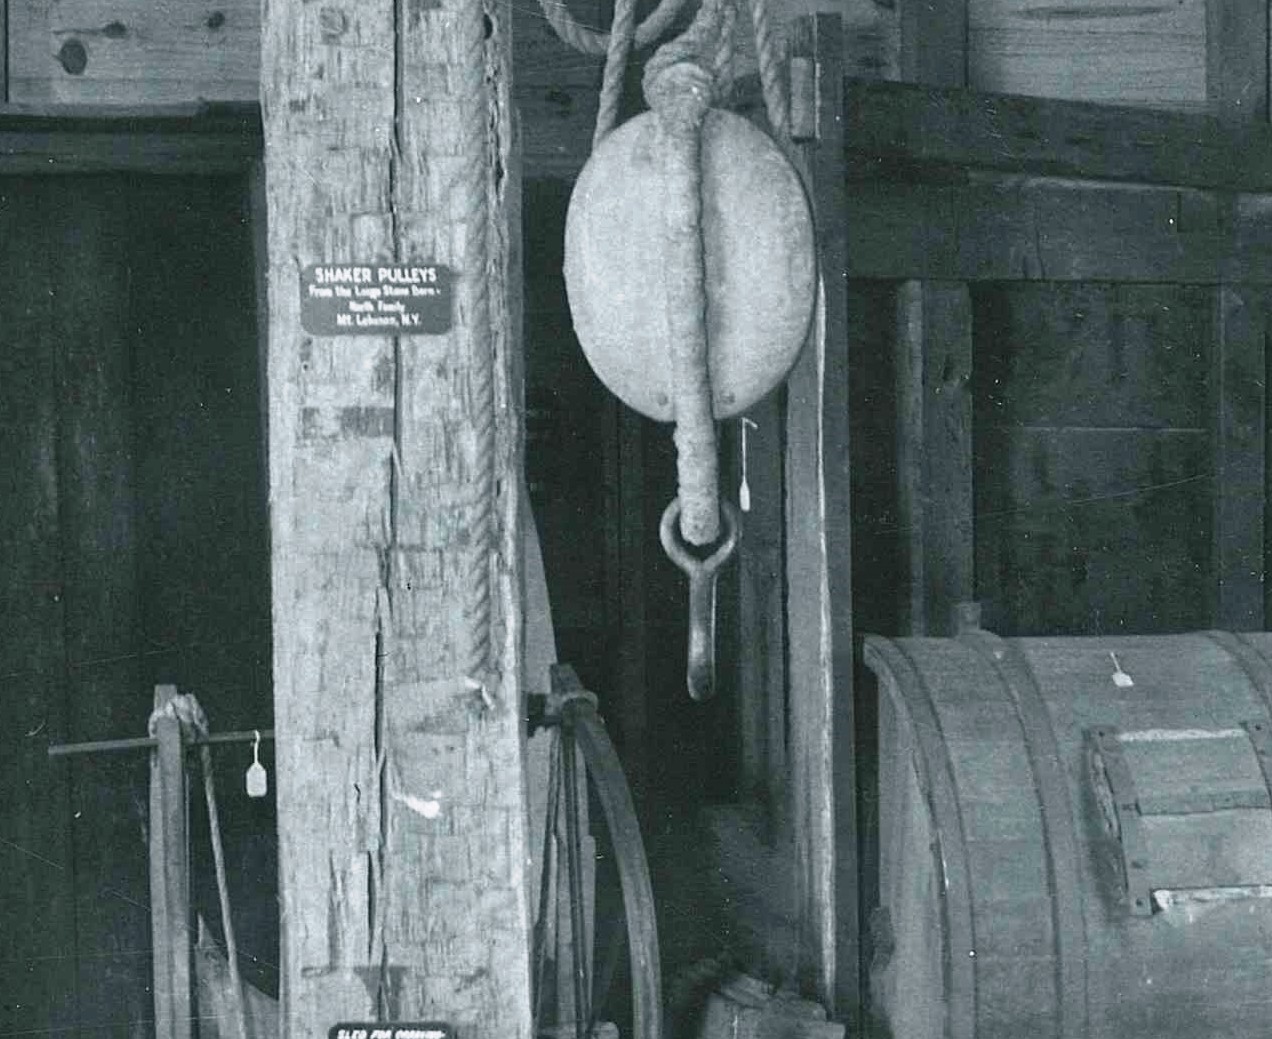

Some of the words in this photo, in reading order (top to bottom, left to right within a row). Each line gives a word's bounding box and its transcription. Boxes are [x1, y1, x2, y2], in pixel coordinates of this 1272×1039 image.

[315, 267, 372, 283] SHAKER
[378, 267, 437, 283] PULLEYS
[308, 285, 333, 297] From
[335, 286, 351, 297] the
[378, 300, 405, 313] Family
